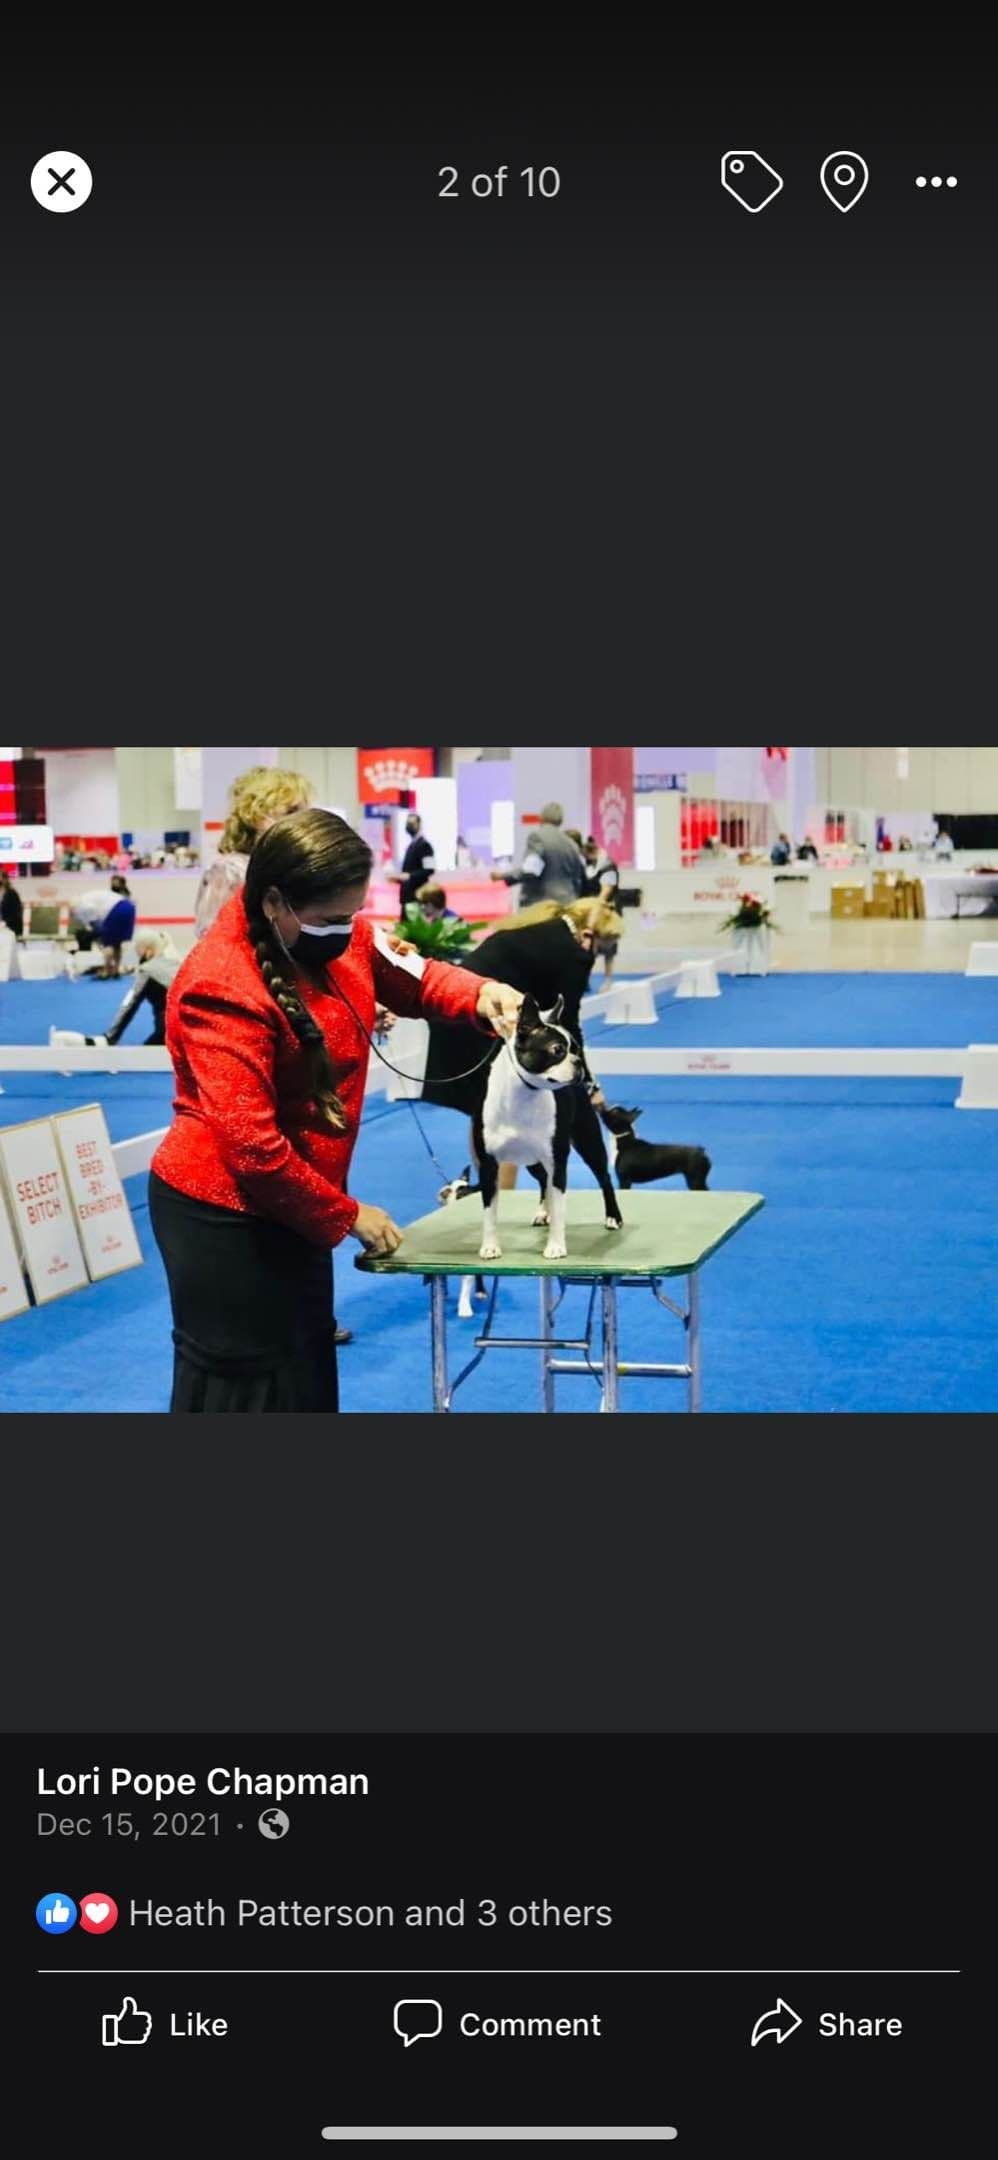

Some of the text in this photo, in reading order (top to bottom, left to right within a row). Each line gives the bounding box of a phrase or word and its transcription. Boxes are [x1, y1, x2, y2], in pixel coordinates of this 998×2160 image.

[17, 1171, 60, 1202] SELECT
[26, 1198, 62, 1225] BITCH
[78, 1193, 123, 1220] EXHIBITOR
